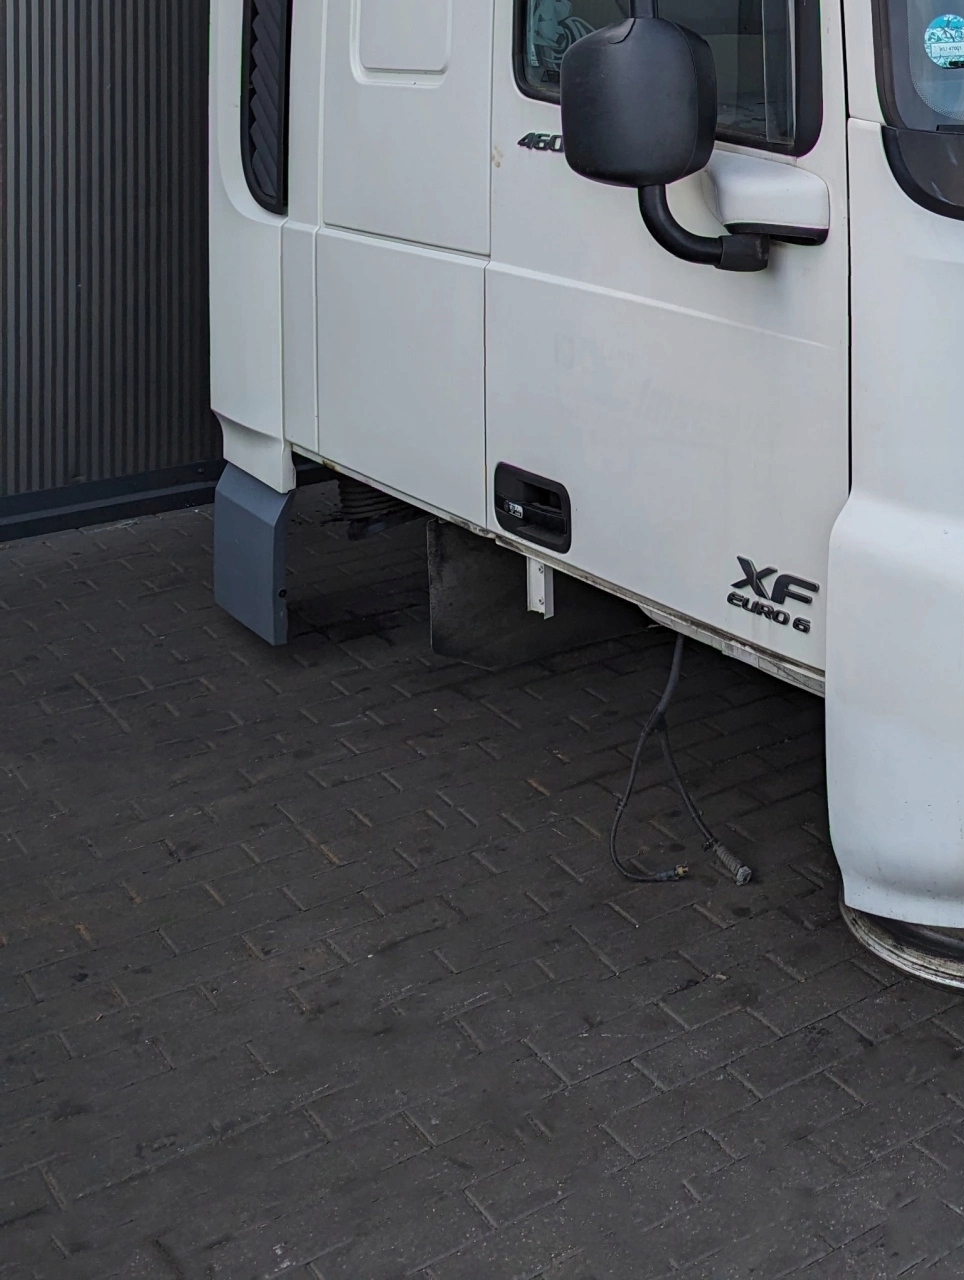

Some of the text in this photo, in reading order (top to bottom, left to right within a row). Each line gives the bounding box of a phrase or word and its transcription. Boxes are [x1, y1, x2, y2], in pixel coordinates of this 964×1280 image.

[517, 132, 564, 152] 460
[729, 555, 820, 605] XF
[727, 590, 811, 633] EURO 6
